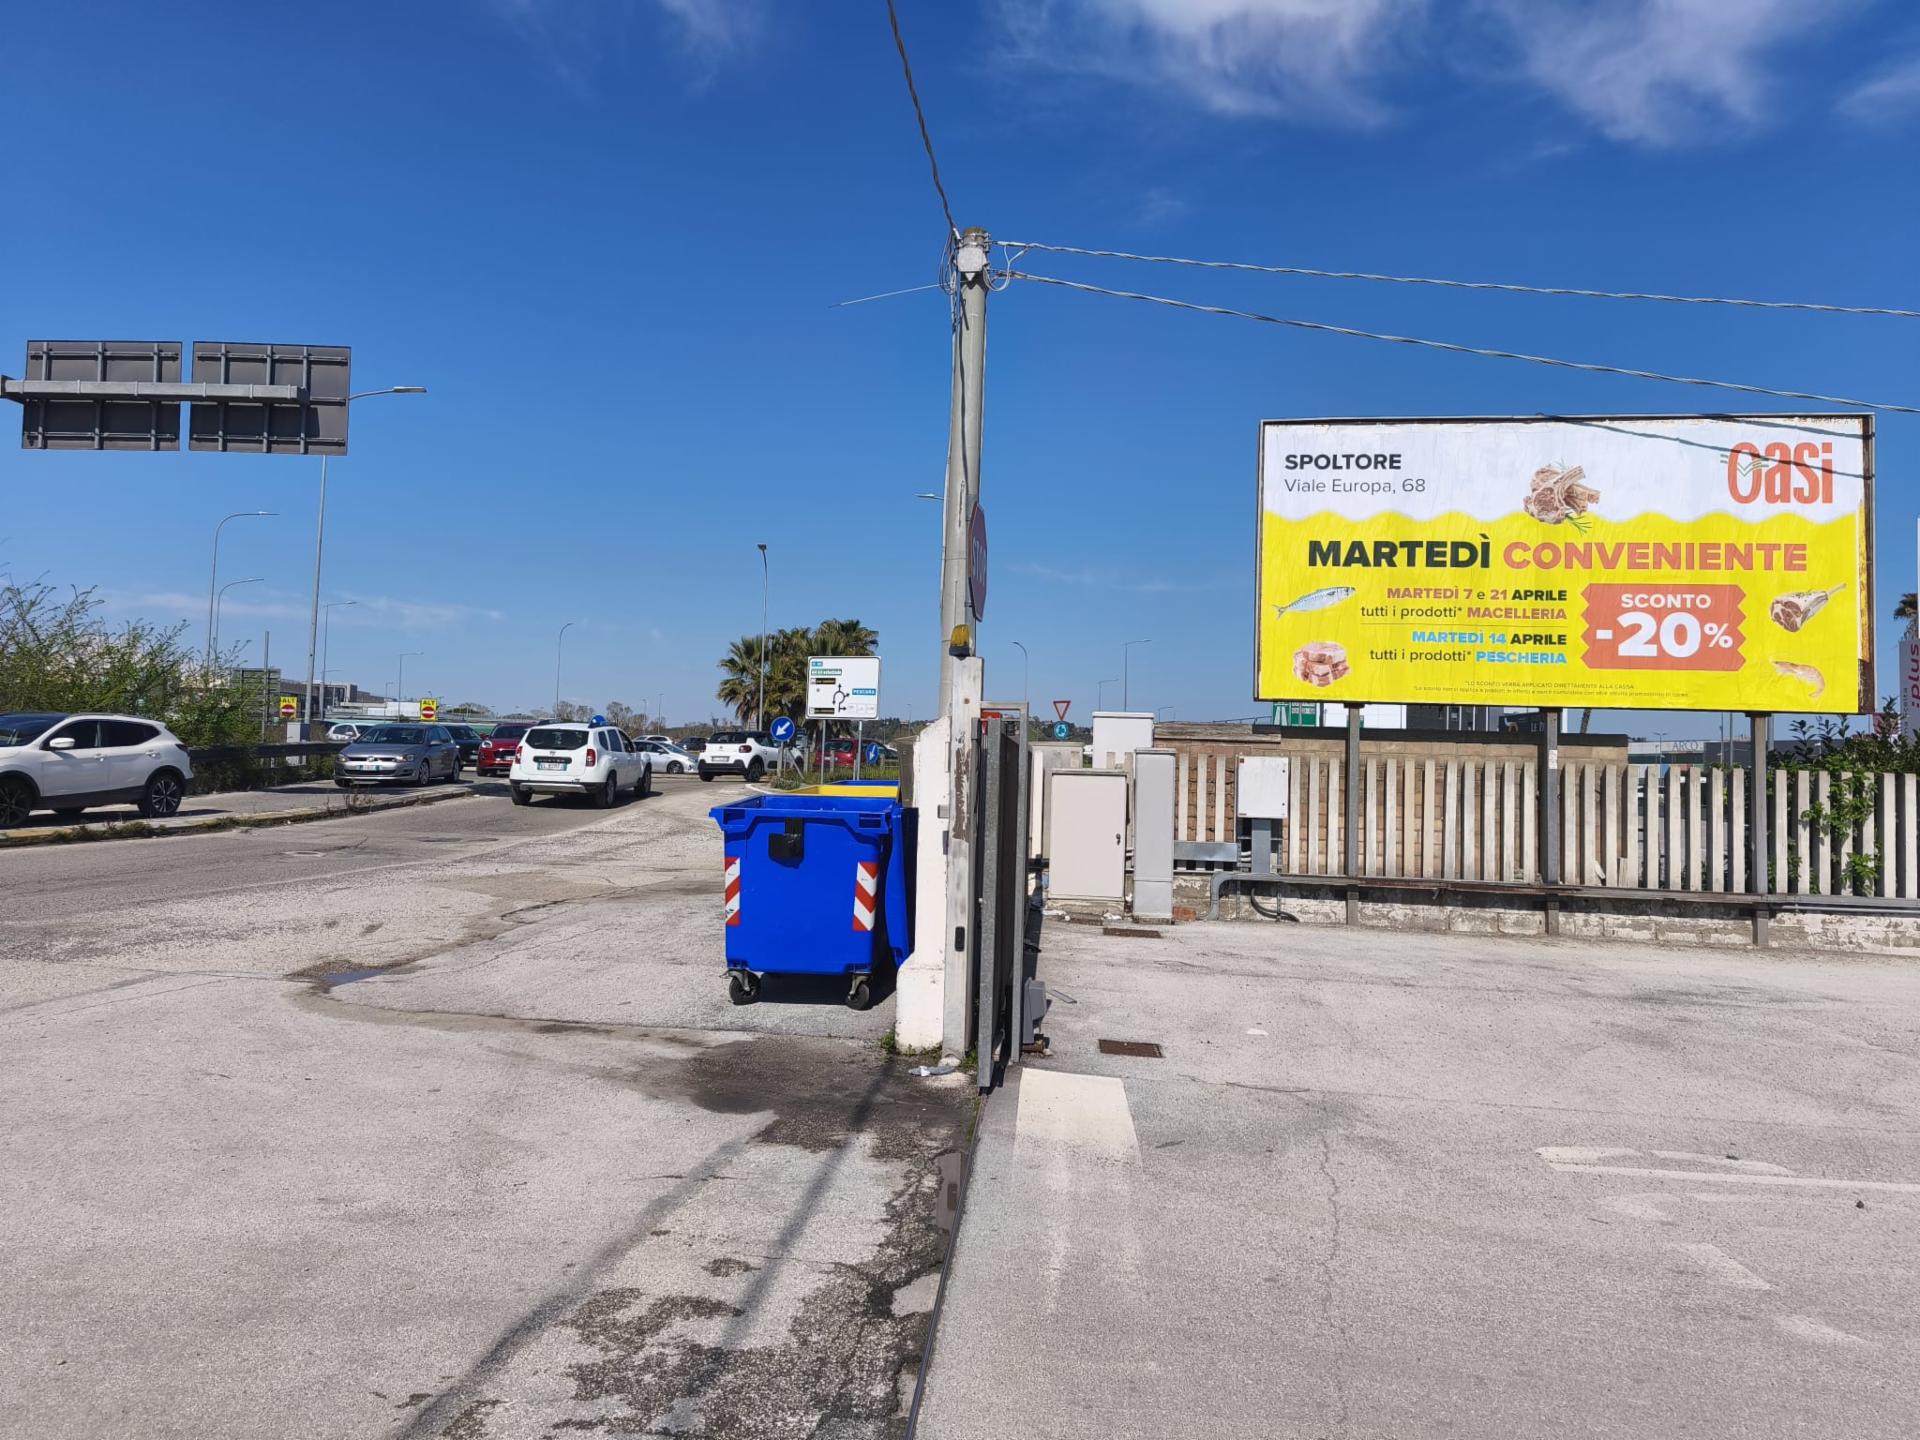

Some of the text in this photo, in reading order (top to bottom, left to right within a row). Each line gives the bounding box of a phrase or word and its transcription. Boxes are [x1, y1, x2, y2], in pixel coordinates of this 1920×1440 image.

[1284, 453, 1402, 470] SPOLTORE
[1728, 442, 1833, 504] Oasi
[1284, 478, 1426, 495] Viale Europa, 68
[1308, 533, 1808, 570] MARTEDÌ CONVENIENTE
[1387, 586, 1567, 601] MARTEDÌ 7 e 21 APRILE
[1620, 594, 1712, 609] SCONTO
[1361, 606, 1388, 617] tutti
[1393, 606, 1396, 617] i
[1467, 607, 1568, 620] MACELLERIA
[1412, 630, 1567, 645] MARTEDÌ 14 APRILE
[1370, 650, 1397, 661] tutti
[1402, 650, 1405, 660] i
[1476, 651, 1567, 664] PESCHERIA
